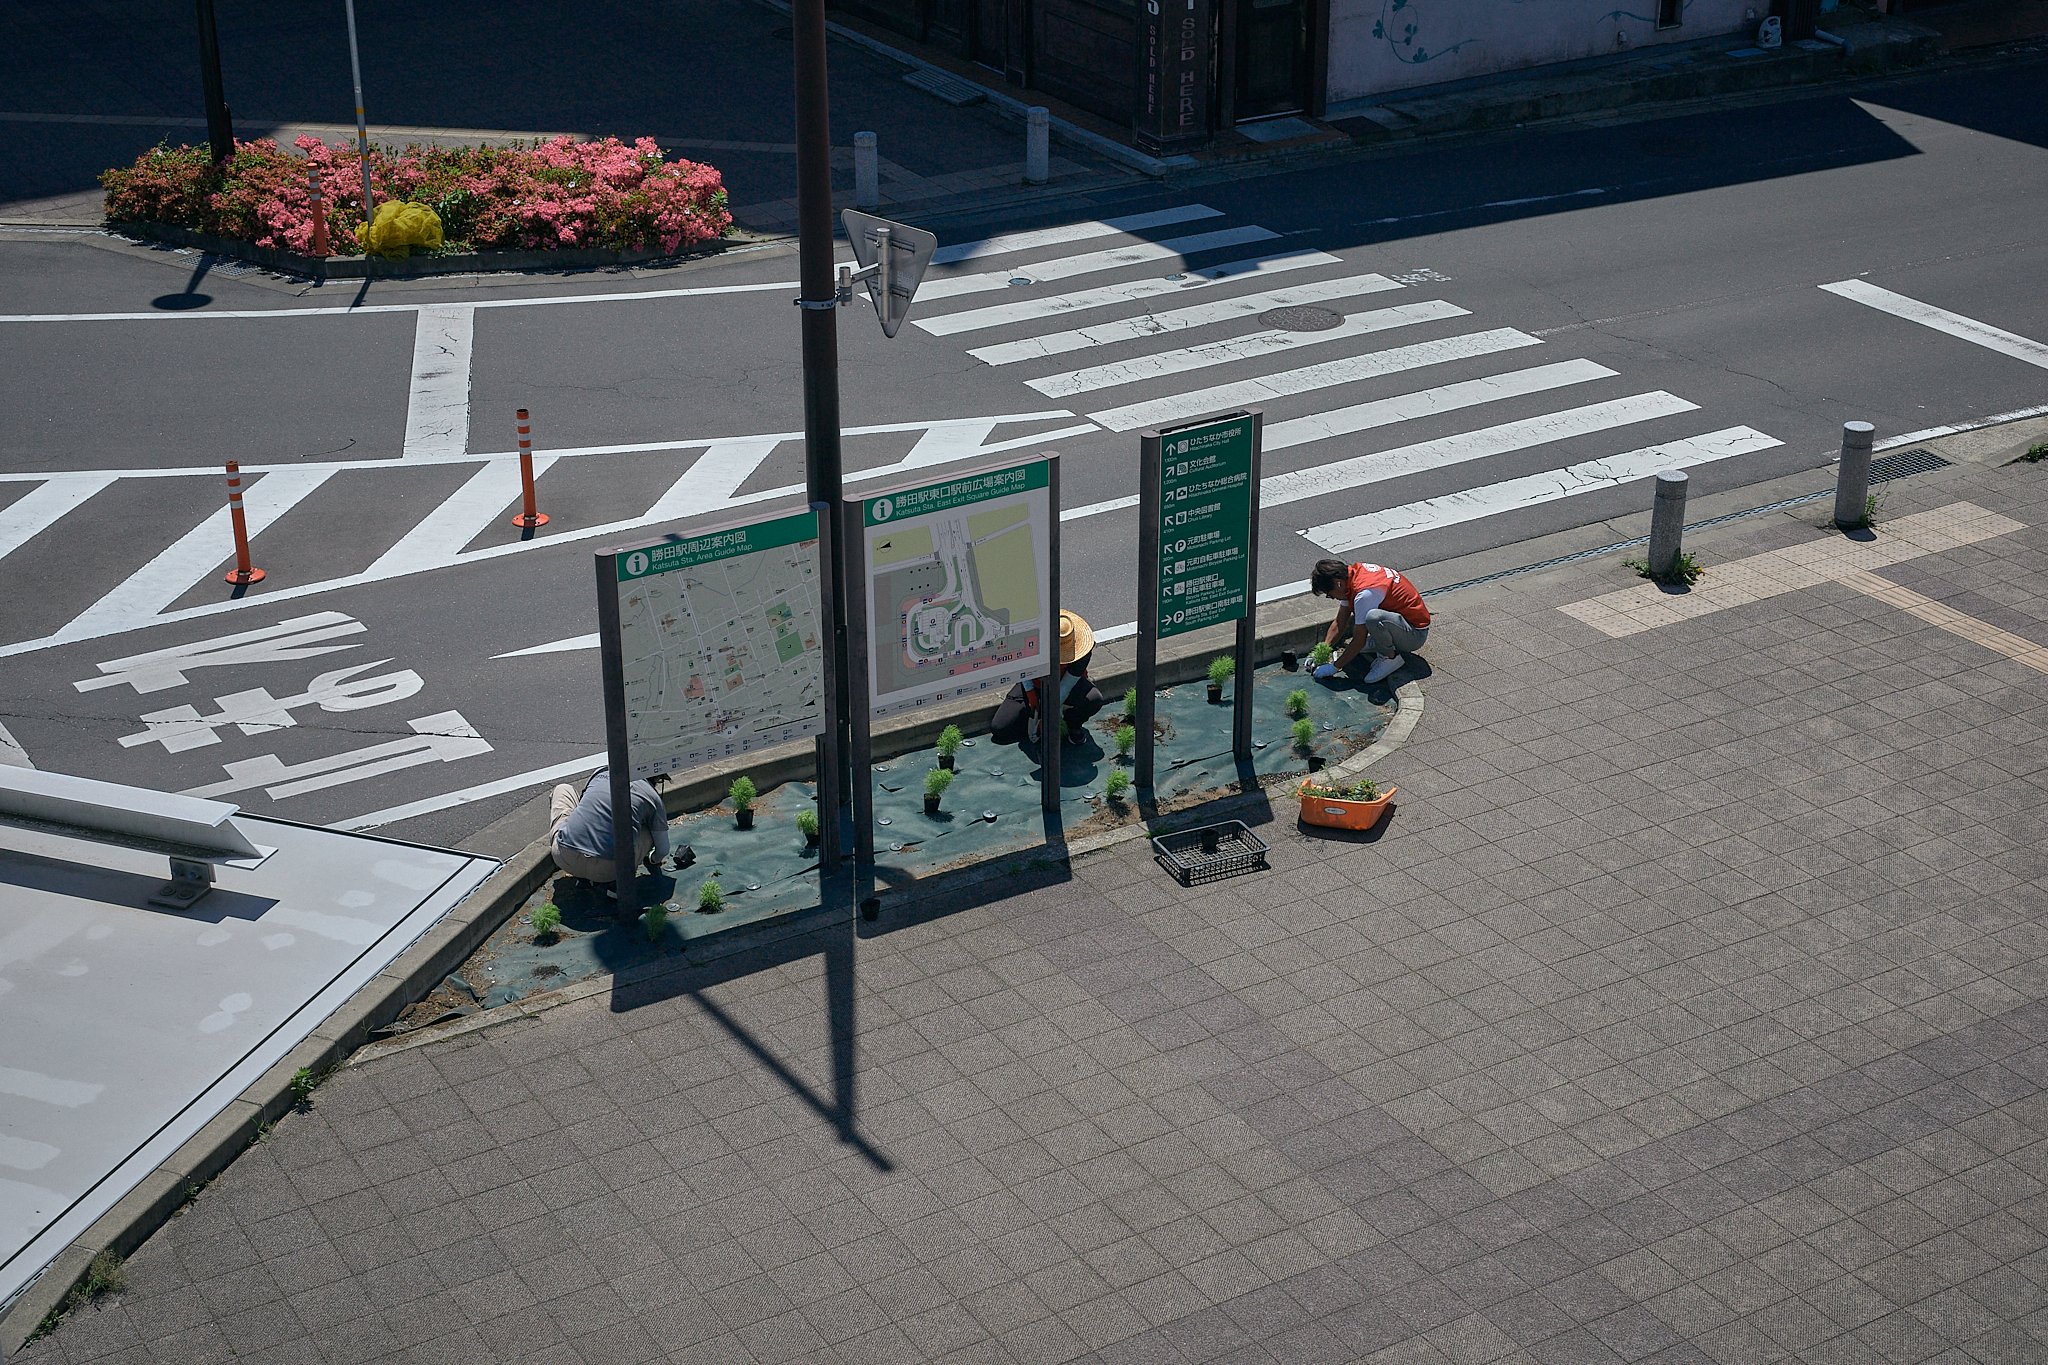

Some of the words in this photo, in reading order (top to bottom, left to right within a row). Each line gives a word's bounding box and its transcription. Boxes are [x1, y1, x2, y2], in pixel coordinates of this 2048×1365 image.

[1180, 71, 1194, 126] HERE
[1190, 427, 1241, 445] ひたちなか市役所
[1190, 443, 1212, 451] Hitachinaka
[1190, 455, 1216, 468] 文化会館
[1205, 461, 1226, 469] Auditorium
[896, 468, 1026, 509] 勝田駅東口駅前広場案内図
[1189, 472, 1247, 492] ひたちなか総合病院
[896, 506, 921, 517] Katsuta
[923, 503, 935, 511] Sta.
[937, 499, 951, 508] East
[953, 495, 965, 505] Exit
[967, 490, 989, 502] Square
[991, 485, 1010, 496] Guide
[1011, 483, 1025, 493] Map
[1188, 503, 1221, 516] 中央図書館
[1199, 513, 1213, 521] Library
[652, 530, 746, 563] 勝田駅周辺案内図
[1188, 530, 1220, 545] 元町駐車場
[652, 559, 679, 571] Katsuta
[681, 556, 694, 565] Sta.
[697, 551, 713, 562] Area
[714, 547, 735, 558] Guide
[737, 543, 752, 555] Map
[1187, 547, 1239, 567] 元町自転車駐車場
